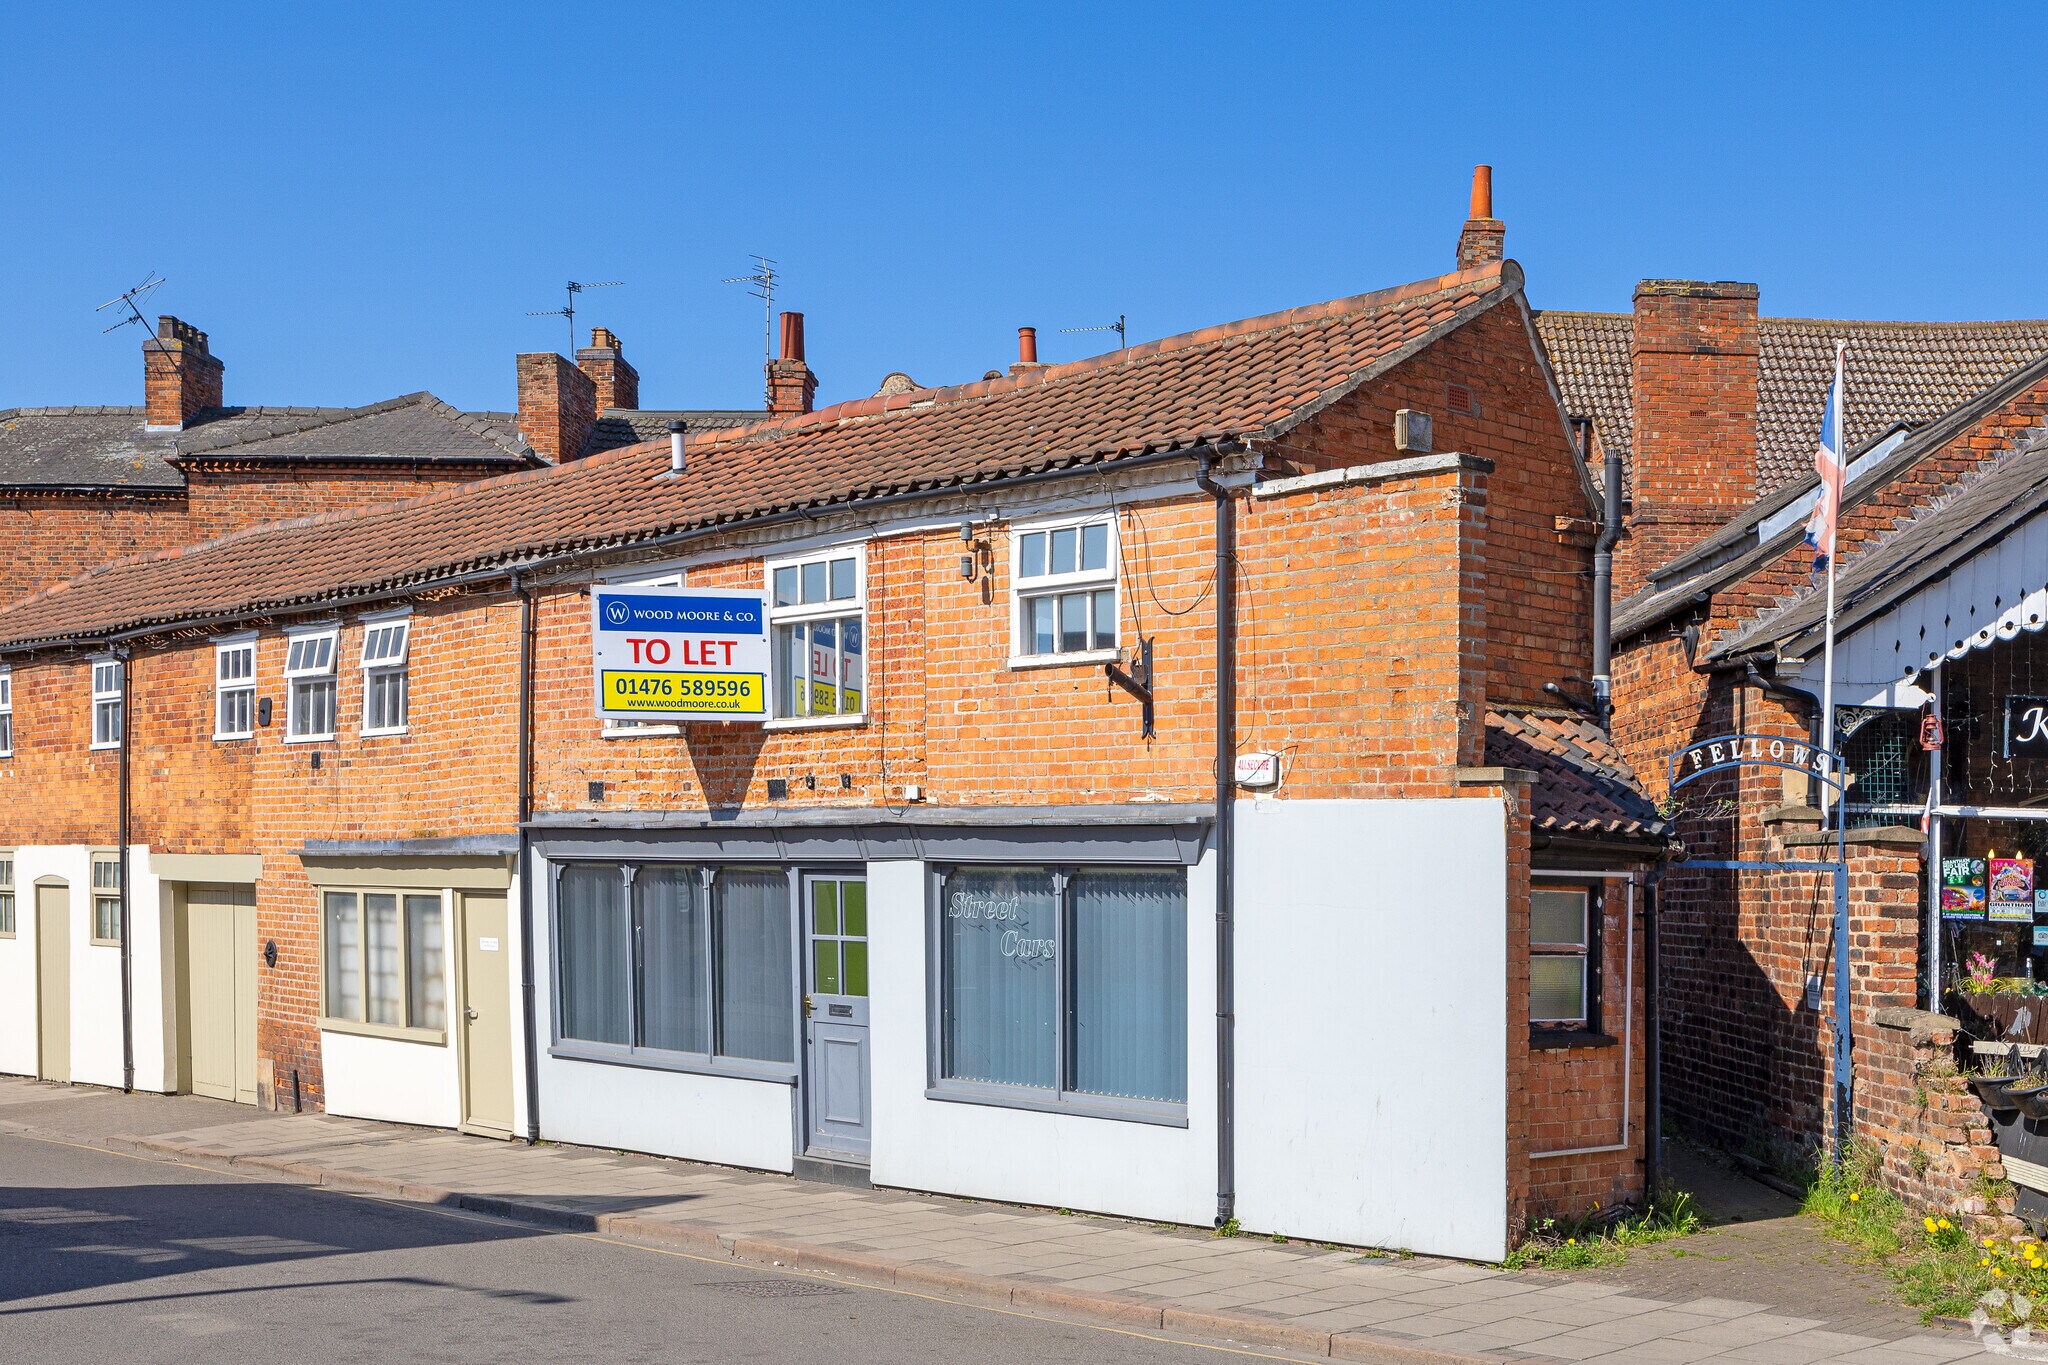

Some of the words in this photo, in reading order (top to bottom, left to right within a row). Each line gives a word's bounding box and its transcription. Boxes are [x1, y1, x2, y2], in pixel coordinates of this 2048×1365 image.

[609, 607, 626, 621] W
[634, 609, 673, 620] WOOD
[676, 610, 720, 621] MOORE
[723, 611, 734, 622] &
[736, 612, 757, 622] CO.
[626, 638, 671, 665] TO
[683, 640, 738, 666] LET
[616, 678, 673, 696] 01476
[680, 679, 751, 697] 589596
[627, 698, 741, 709] www.woodmoore.co.uk
[1689, 739, 1828, 771] FELLOWS
[1943, 866, 1970, 877] FAIR
[949, 892, 1018, 920] Street
[1000, 930, 1055, 958] Cars
